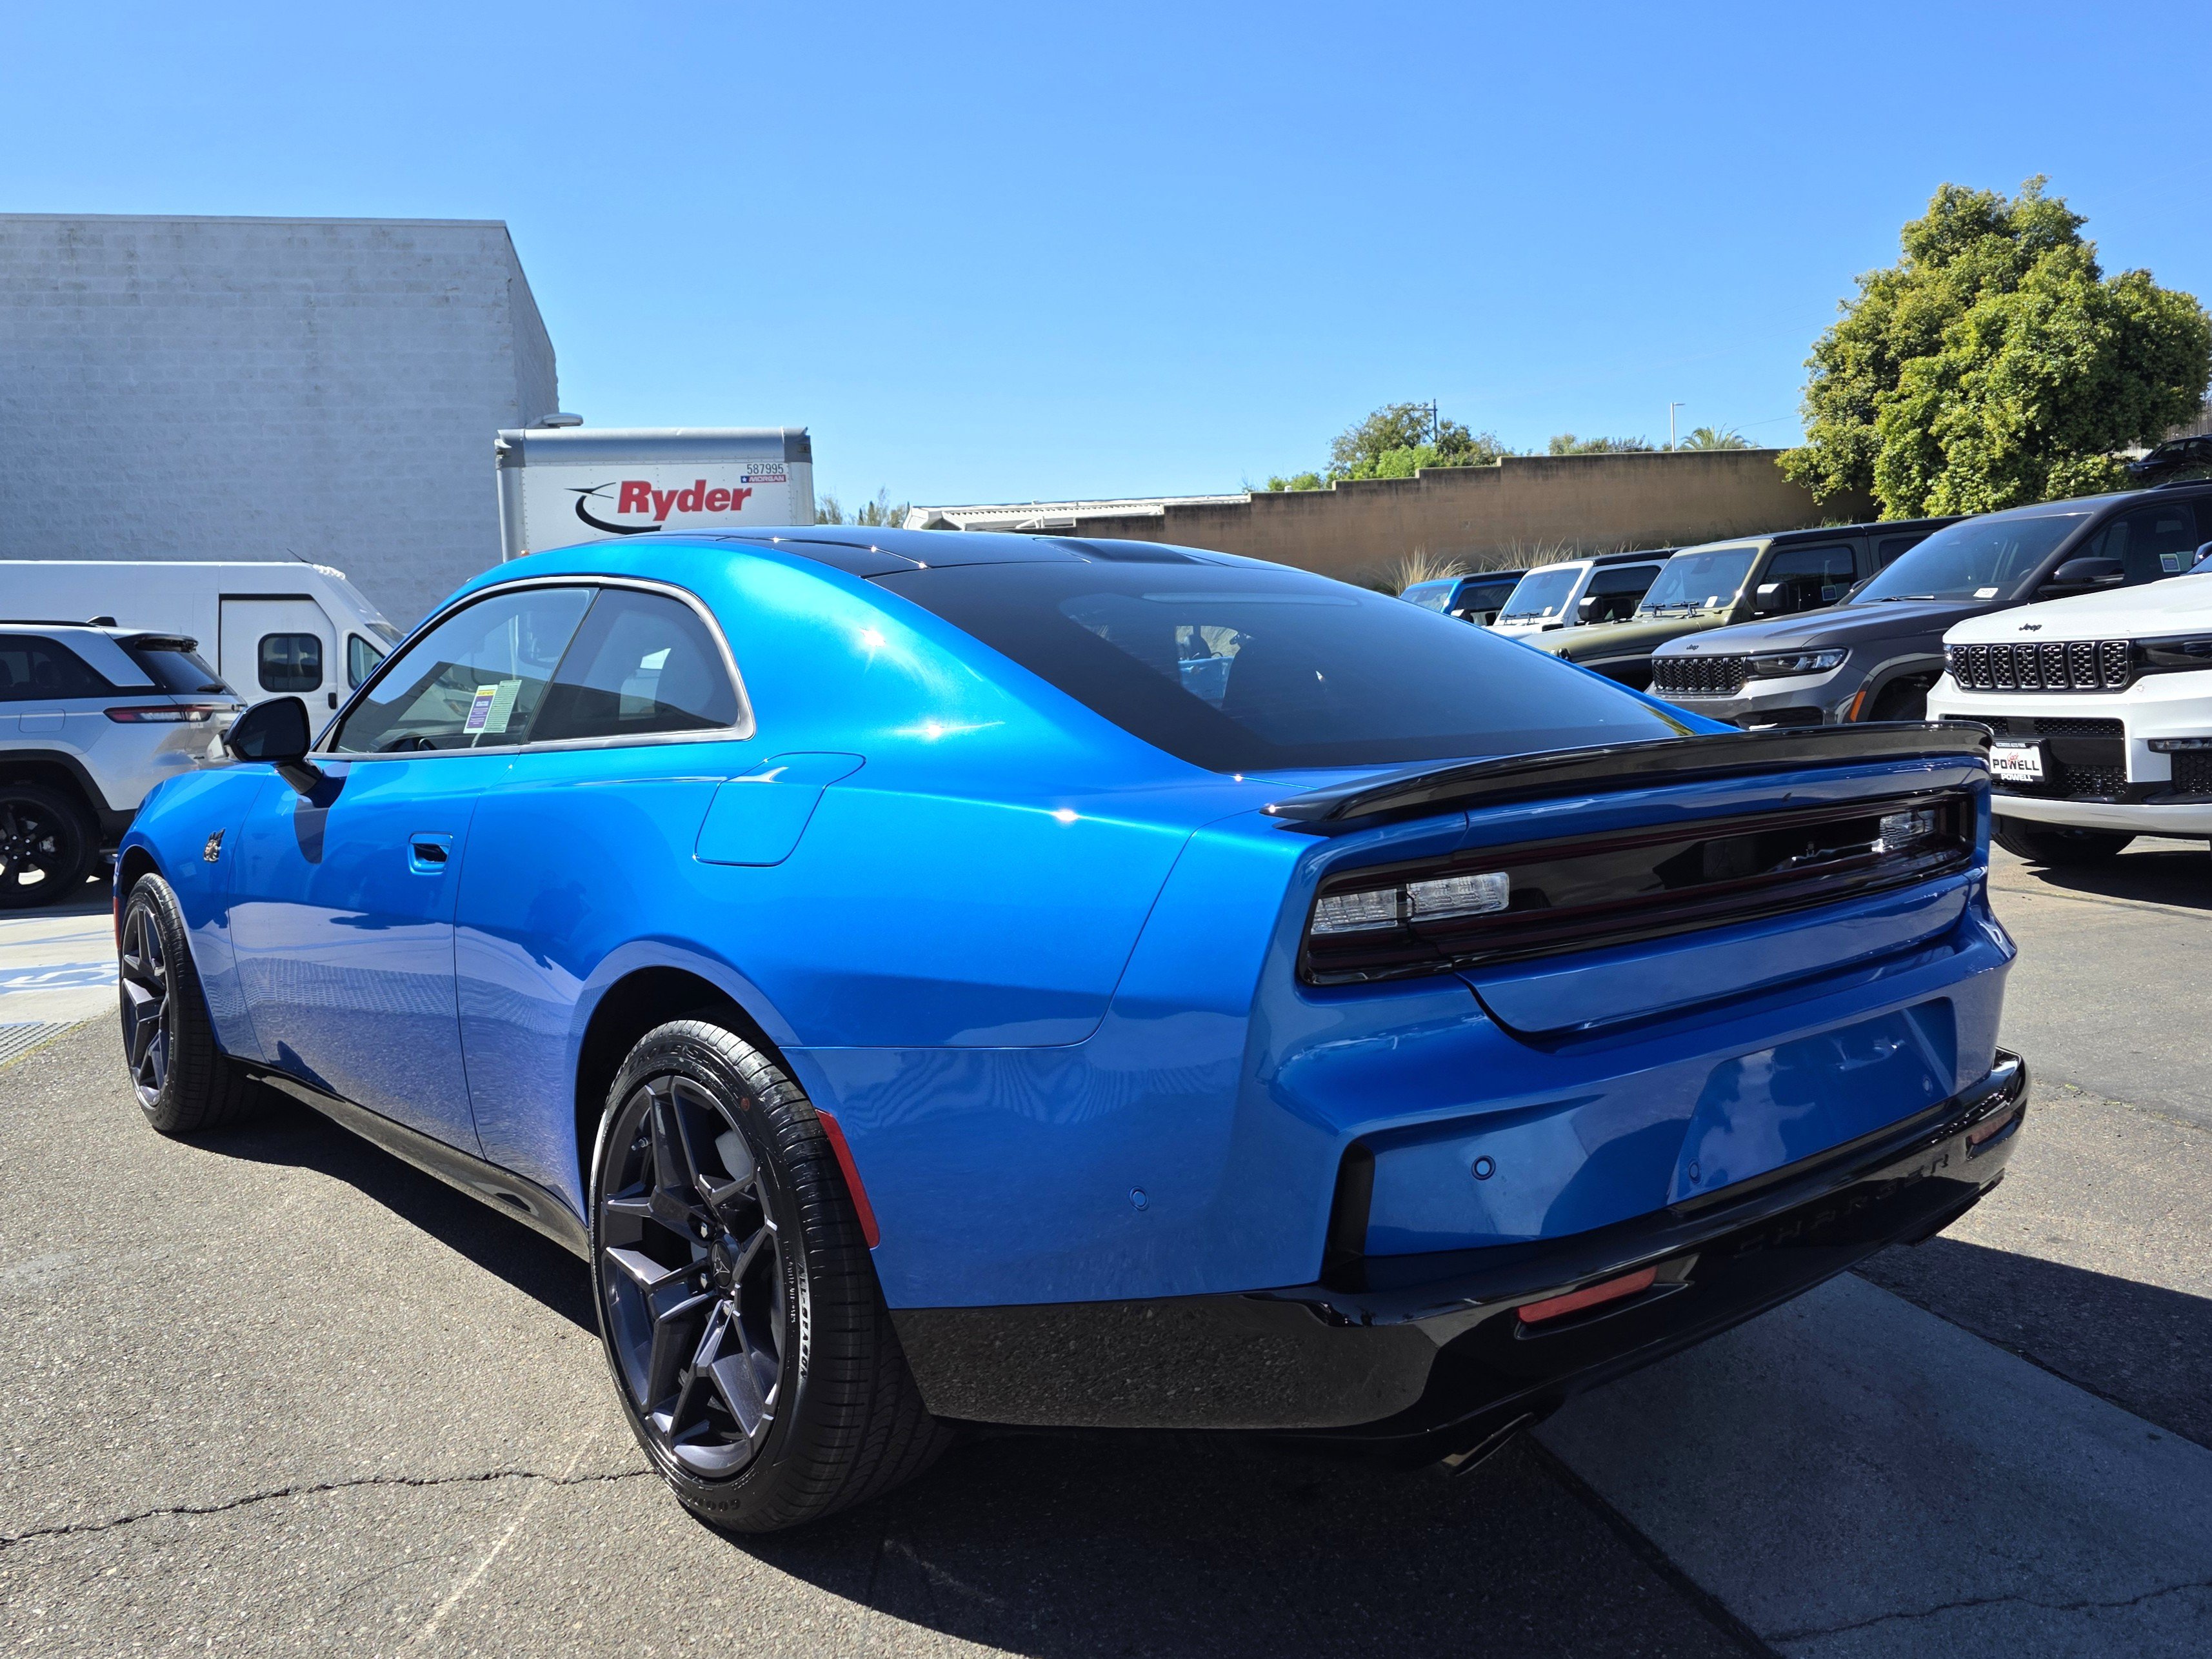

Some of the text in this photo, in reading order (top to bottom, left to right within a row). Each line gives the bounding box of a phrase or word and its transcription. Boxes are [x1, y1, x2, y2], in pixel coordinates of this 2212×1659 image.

[746, 463, 784, 474] 587995
[617, 479, 752, 521] Ryder
[2018, 623, 2042, 632] Jeep
[1992, 759, 2040, 771] POWELL
[2000, 773, 2033, 782] POWELL
[797, 1262, 811, 1381] ALL-SEASON
